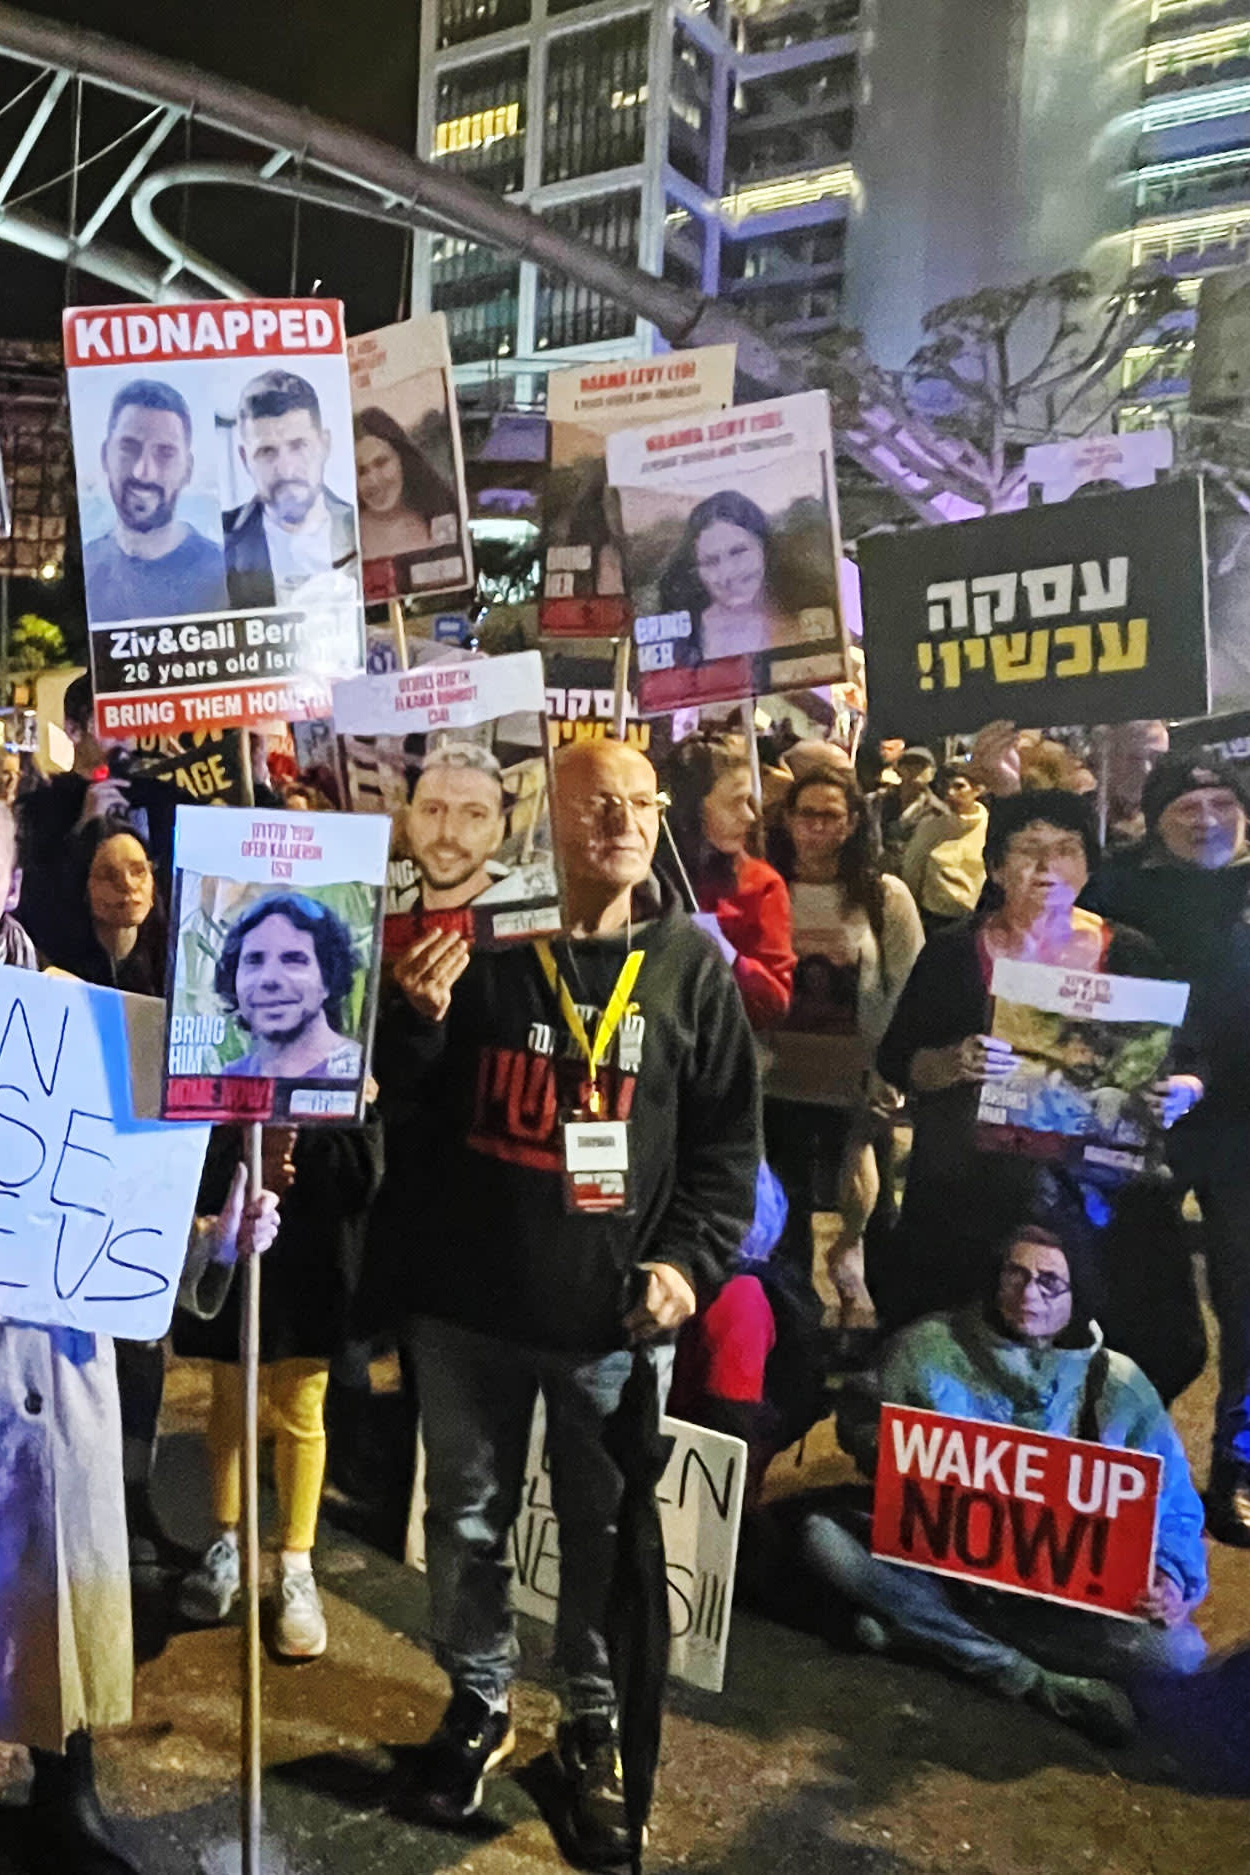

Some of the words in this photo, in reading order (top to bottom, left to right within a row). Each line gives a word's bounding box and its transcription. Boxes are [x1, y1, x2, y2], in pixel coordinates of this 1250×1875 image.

[75, 309, 334, 359] KIDNAPPED
[926, 556, 1129, 636] עסקה
[110, 622, 236, 660] Ziv&Gali
[917, 618, 1148, 691] עכשיו!
[124, 662, 150, 683] 26
[158, 657, 218, 685] years
[225, 652, 259, 674] old
[104, 701, 175, 728] BRING
[181, 695, 243, 722] THEM
[170, 1015, 226, 1045] BRING
[168, 1045, 201, 1075] HIM
[53, 1213, 170, 1301] US
[891, 1419, 1048, 1503] WAKE
[1067, 1453, 1146, 1521] UP
[899, 1478, 1111, 1597] NOW!
